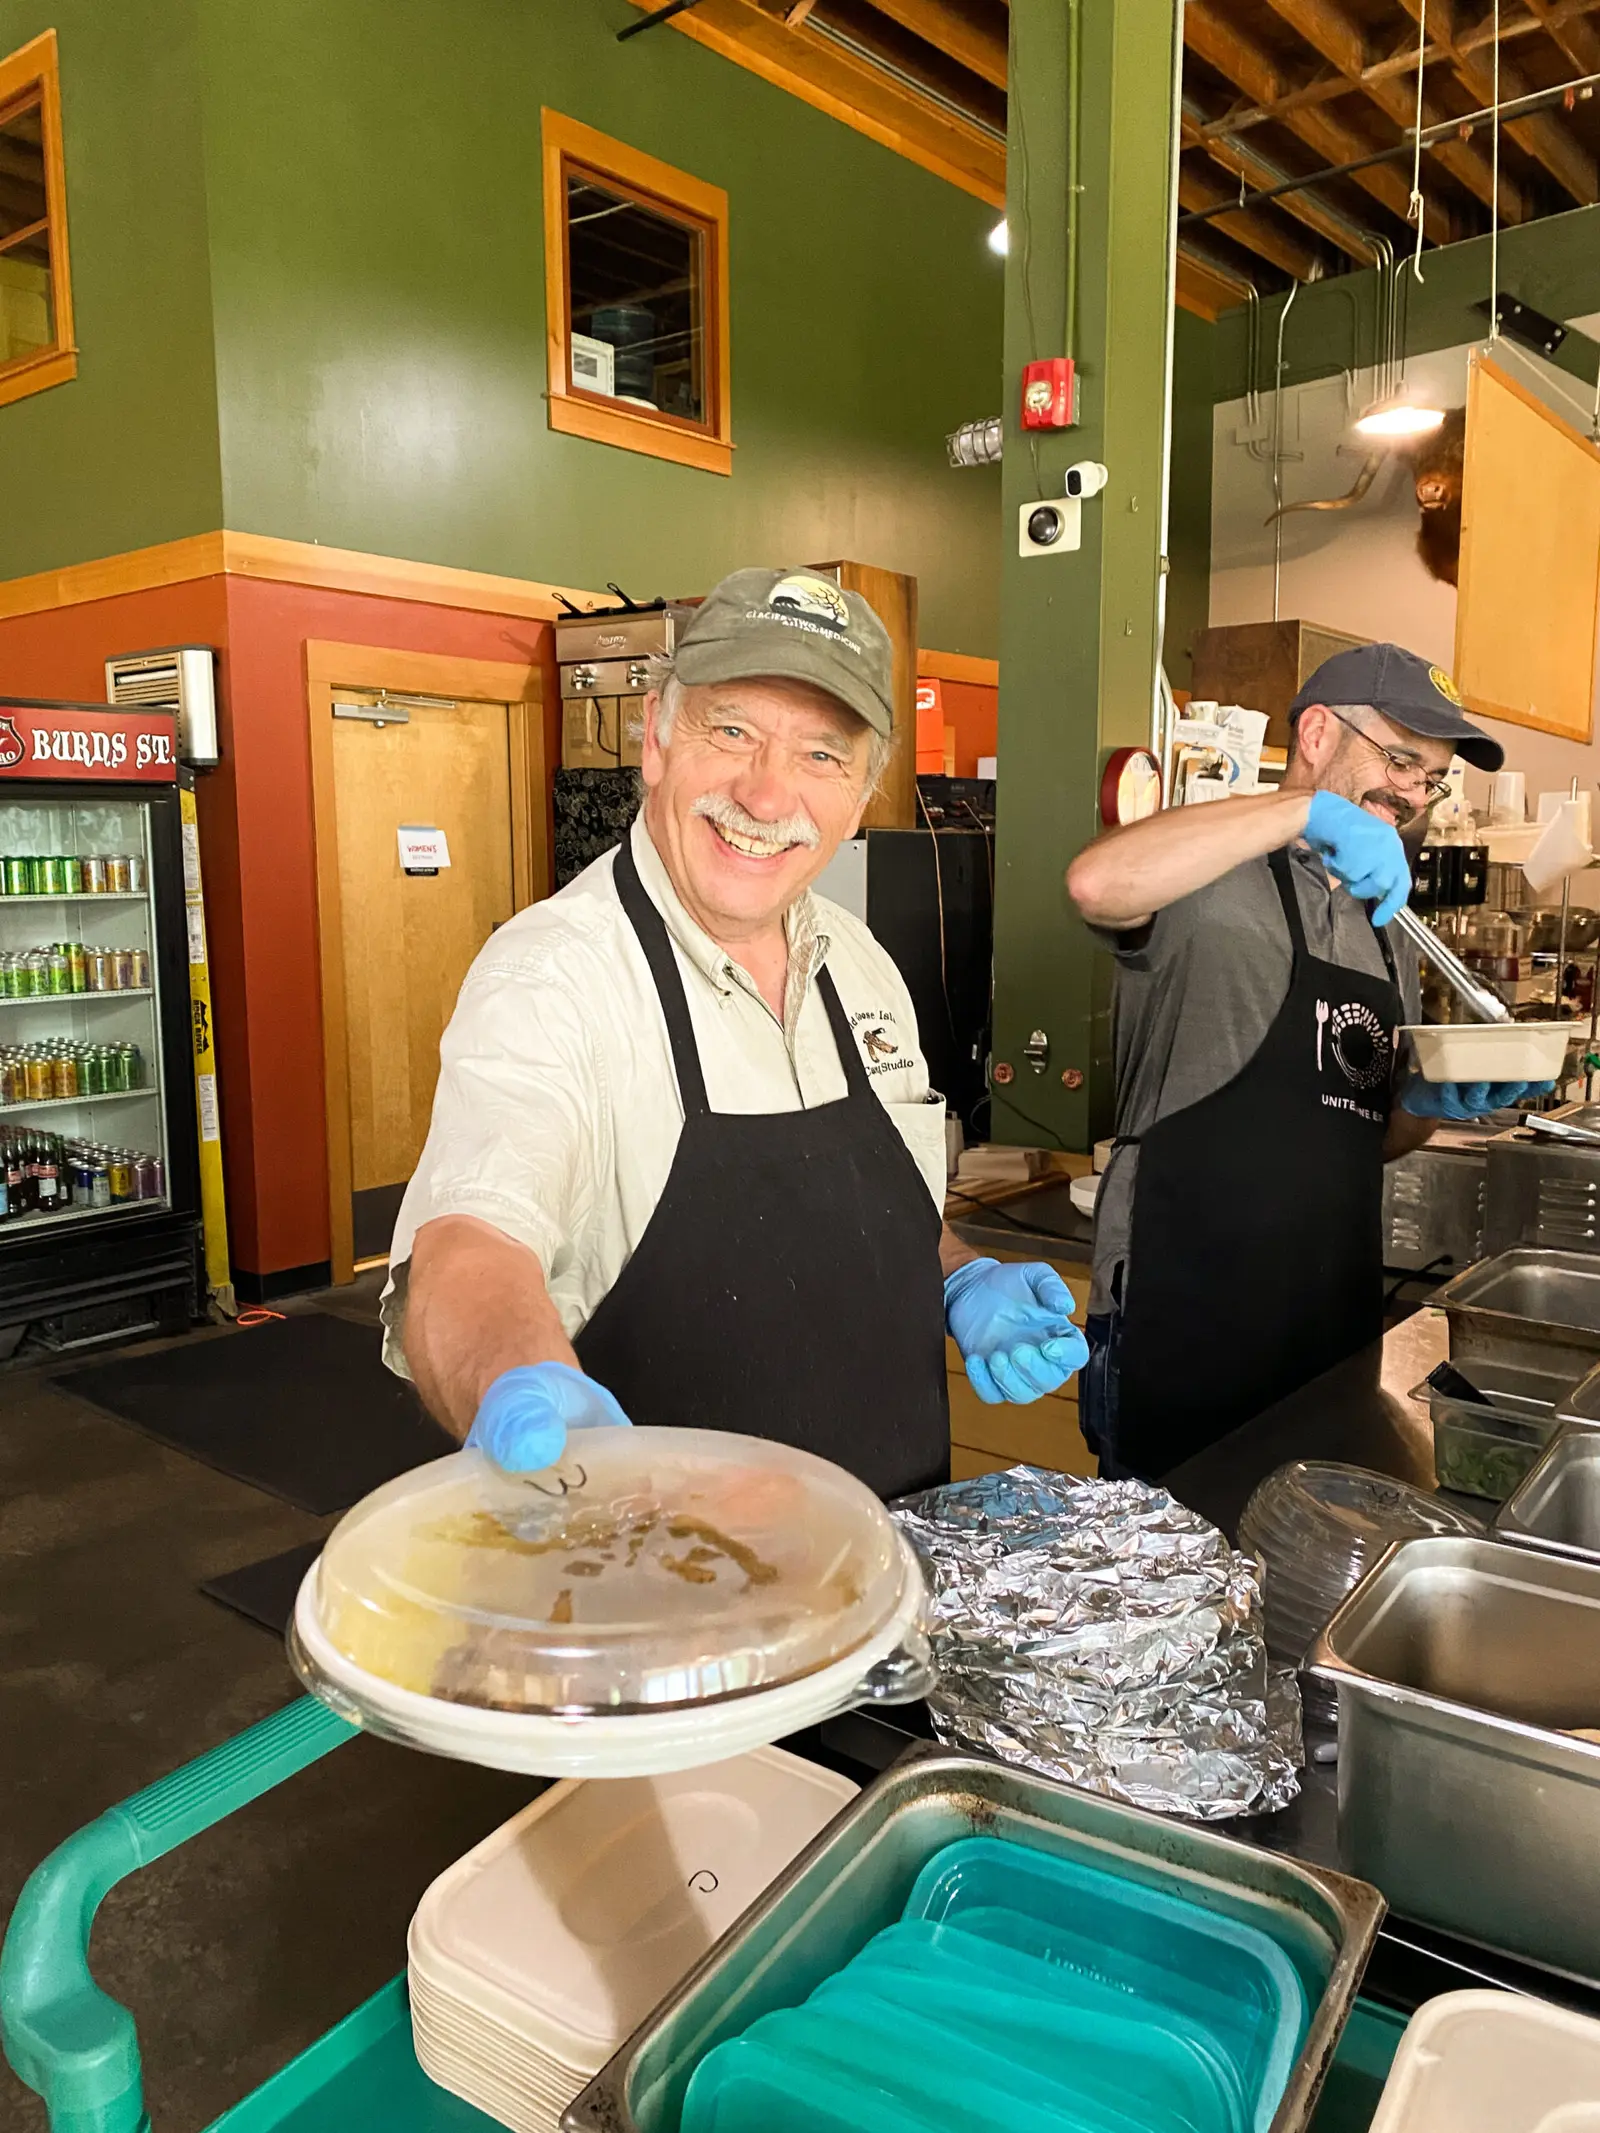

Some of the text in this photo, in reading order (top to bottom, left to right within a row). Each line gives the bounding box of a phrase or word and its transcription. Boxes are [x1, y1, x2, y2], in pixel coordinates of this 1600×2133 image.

[31, 728, 177, 769] BURNS ST.
[1321, 1093, 1358, 1112] UNITE
